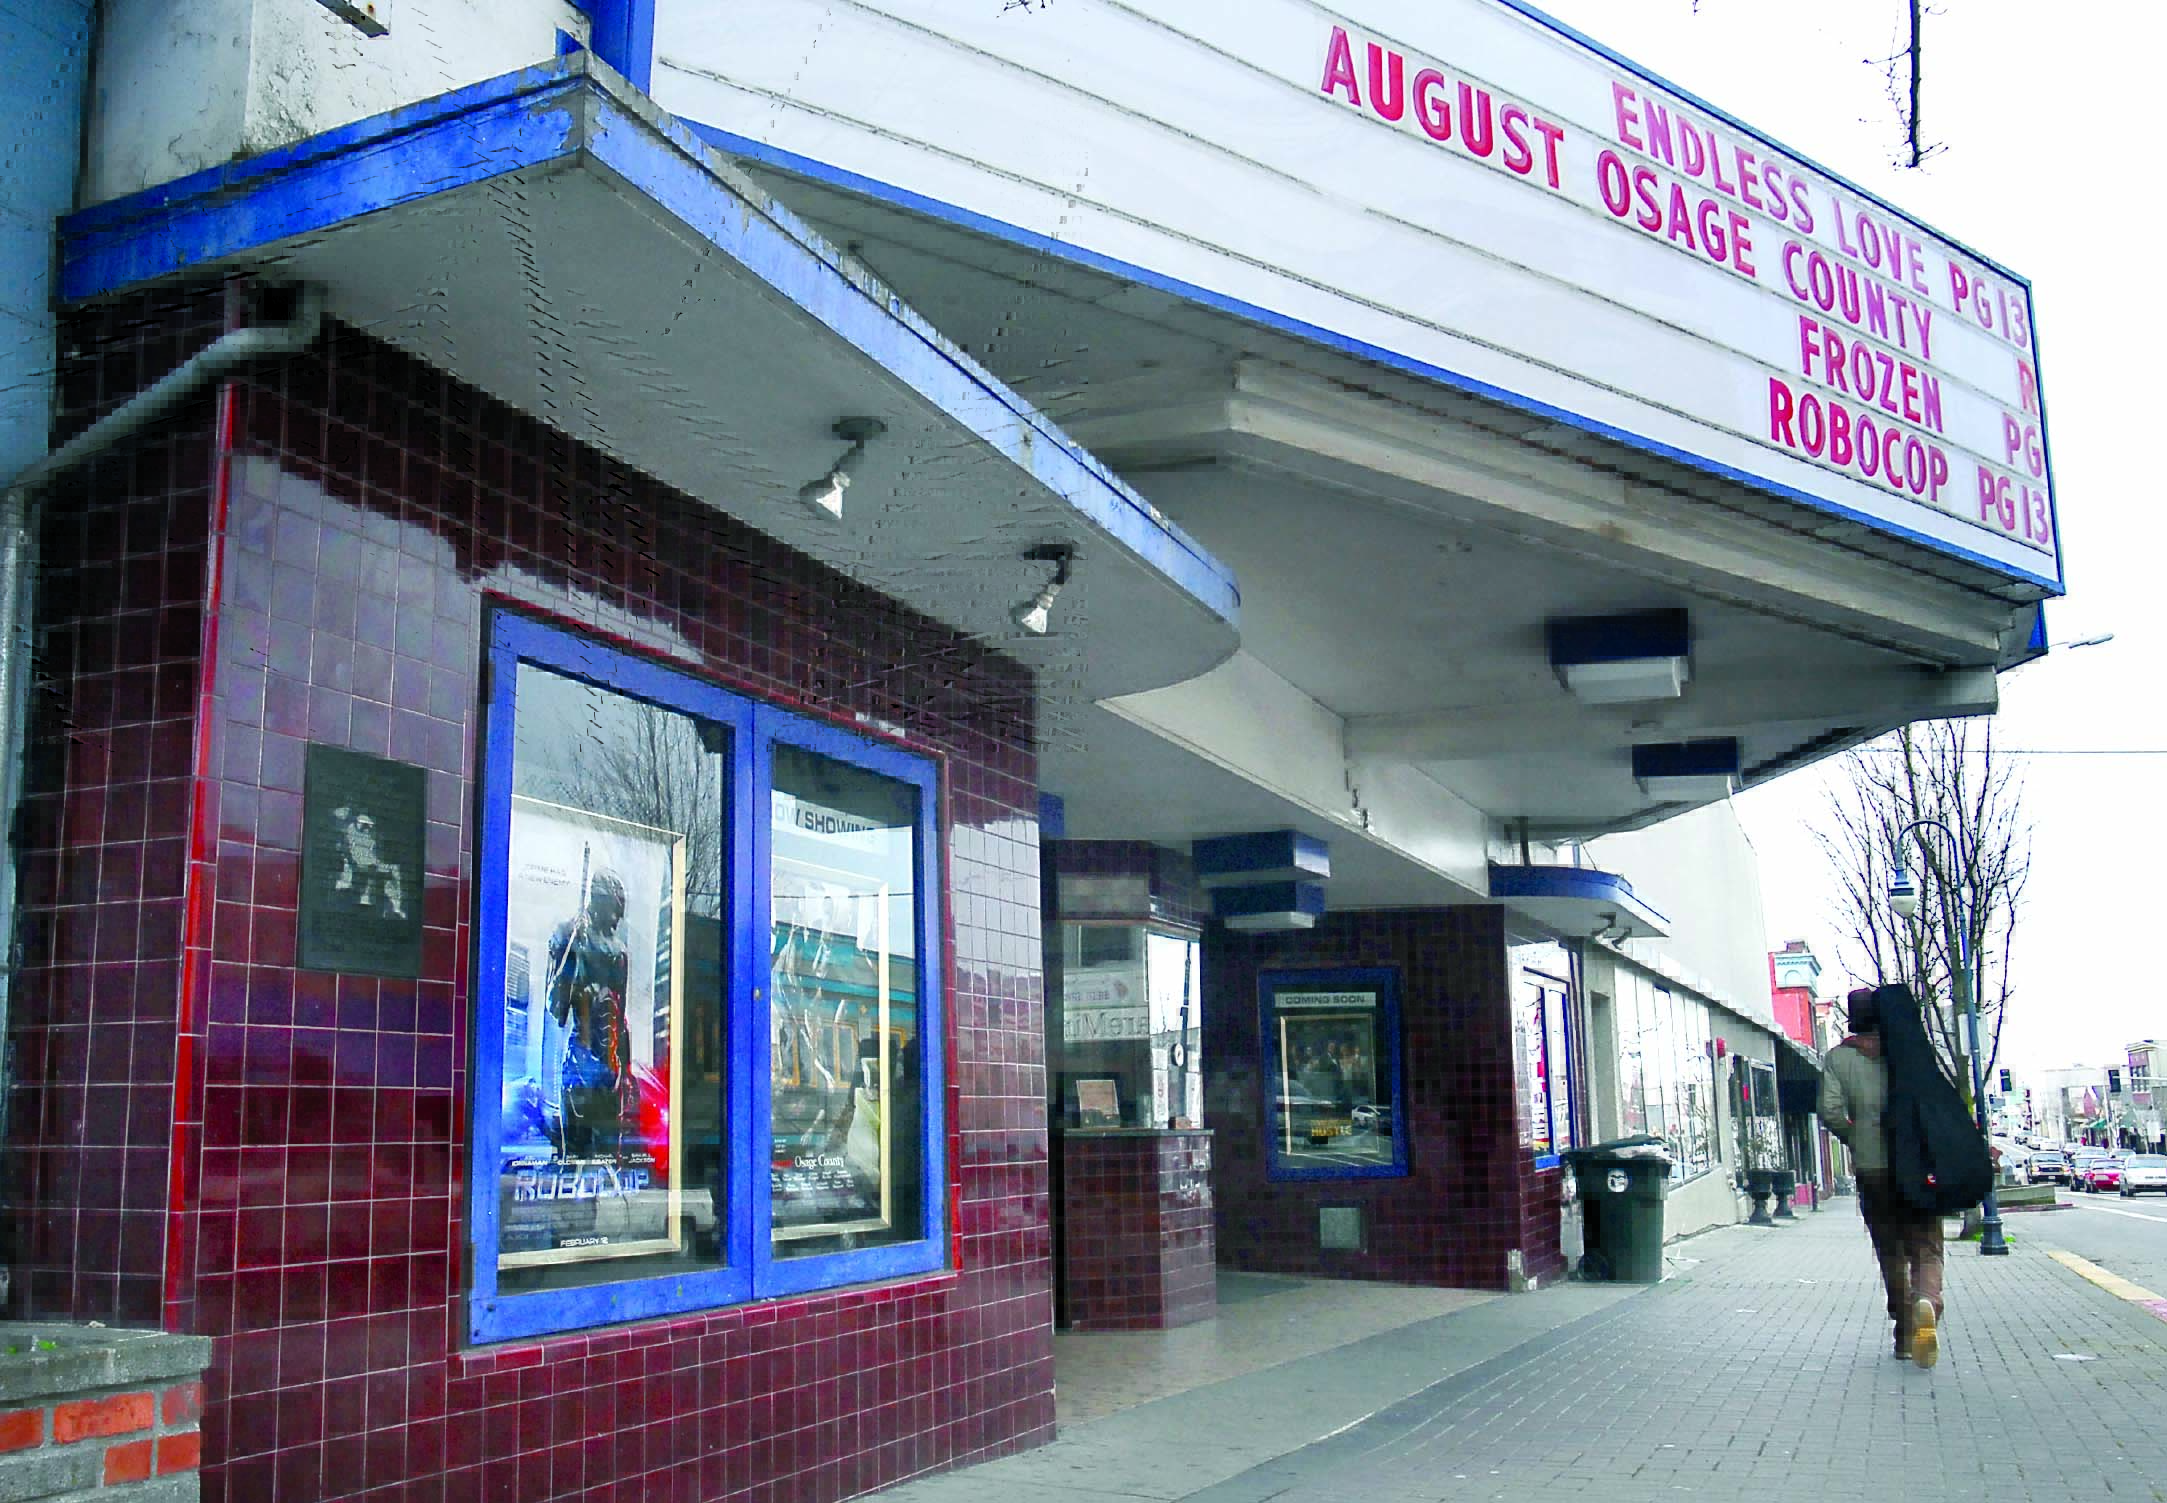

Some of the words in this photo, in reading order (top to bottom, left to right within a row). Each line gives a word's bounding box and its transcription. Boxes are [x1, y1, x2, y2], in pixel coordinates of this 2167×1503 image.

[1321, 25, 1564, 190] AUGUST
[1597, 149, 1757, 278] OSAGE
[1783, 240, 1932, 360] COUNTY
[2018, 359, 2038, 416] R
[1612, 80, 1814, 234] ENDLESS
[1832, 196, 1929, 296] LOVE
[1769, 377, 1948, 502] ROBOCOP
[1799, 315, 1944, 434] FROZEN
[2002, 412, 2042, 478] PG
[1285, 996, 1330, 1005] COMING
[1332, 994, 1365, 1004] SOON
[794, 1155, 817, 1170] Osage
[817, 1153, 844, 1168] County
[560, 1237, 599, 1248] FEBRUARY
